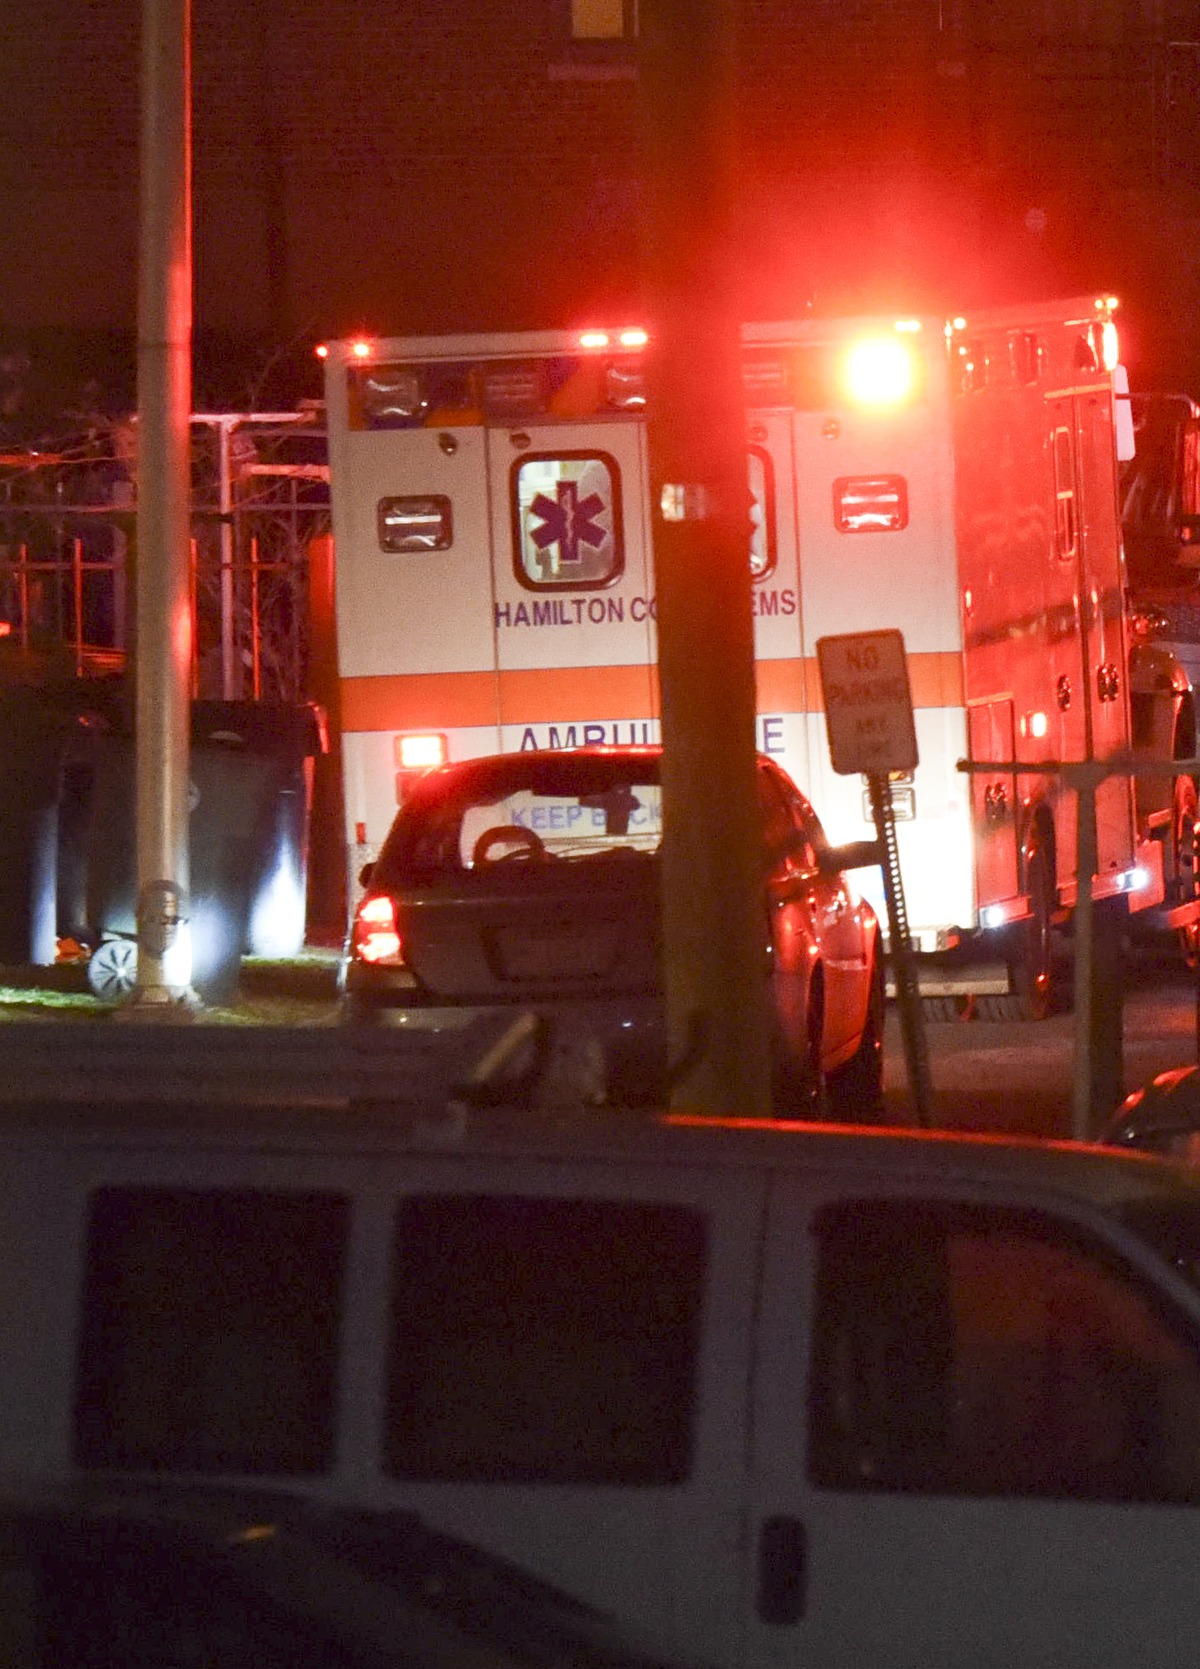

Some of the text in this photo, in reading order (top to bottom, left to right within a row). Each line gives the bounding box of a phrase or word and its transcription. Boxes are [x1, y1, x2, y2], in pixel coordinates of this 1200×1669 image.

[495, 597, 624, 628] HAMILTON
[844, 645, 881, 672] NO
[520, 717, 786, 753] AMBULE
[510, 804, 583, 831] KEEP
